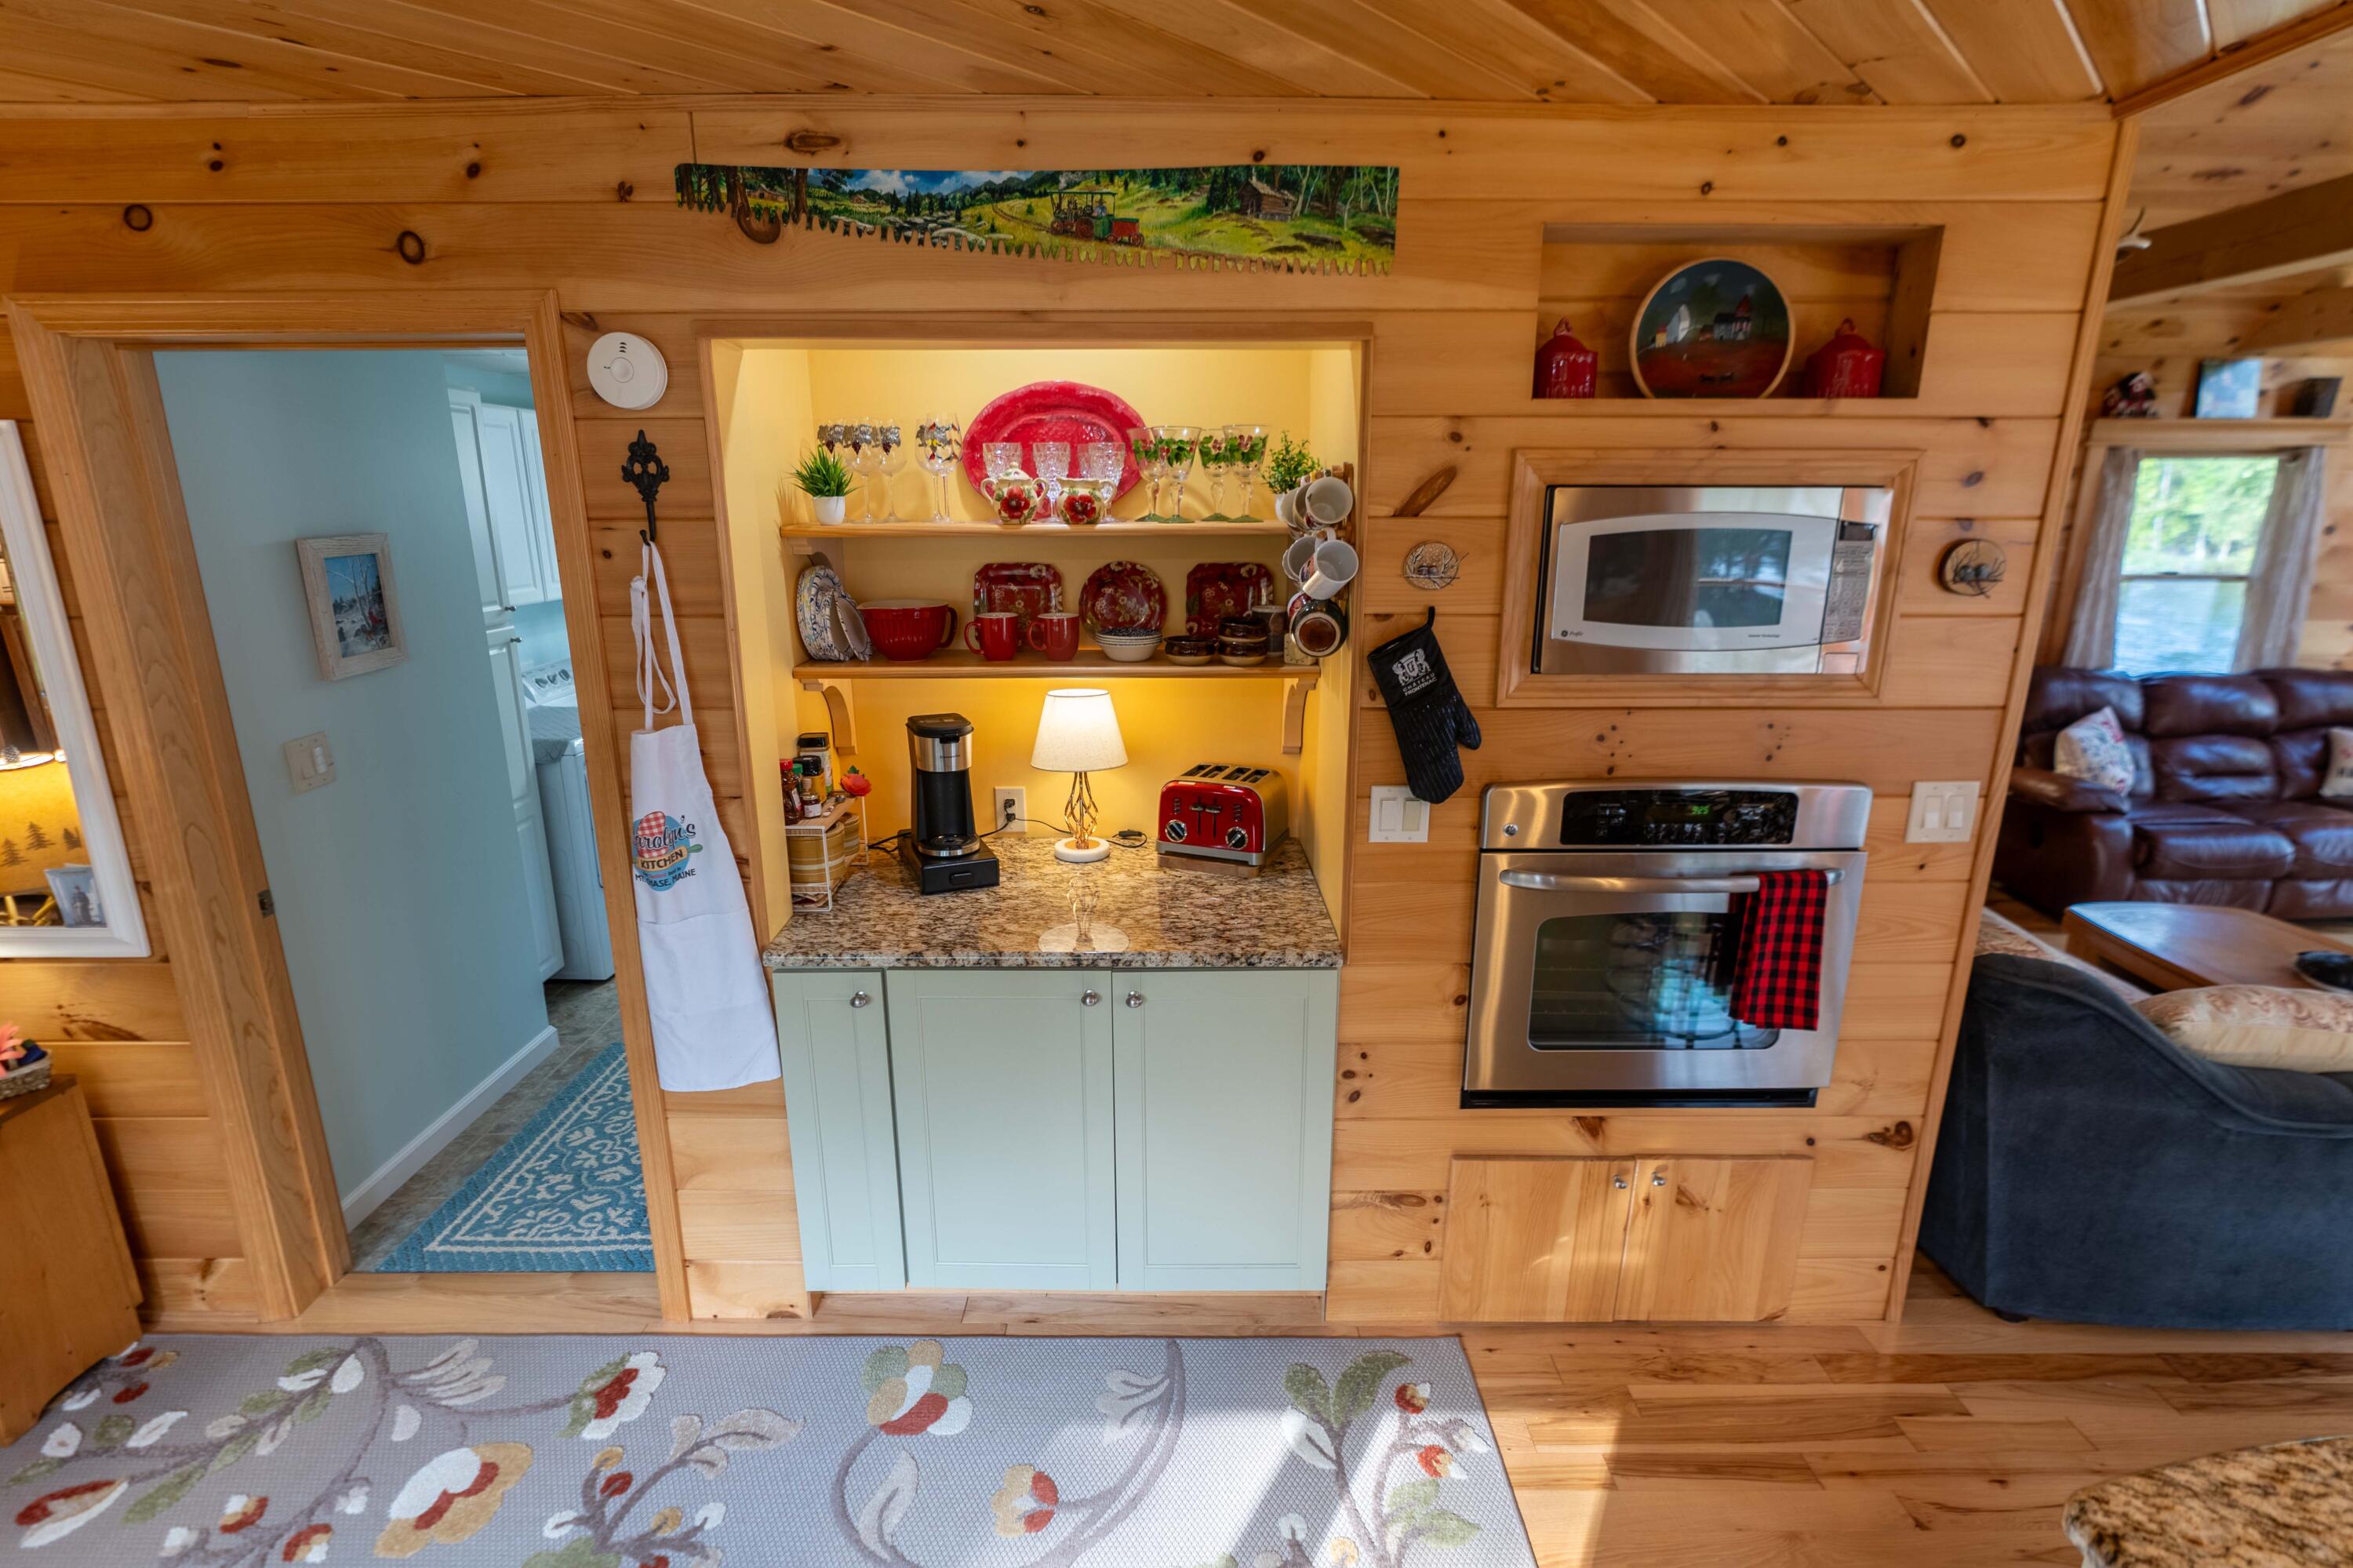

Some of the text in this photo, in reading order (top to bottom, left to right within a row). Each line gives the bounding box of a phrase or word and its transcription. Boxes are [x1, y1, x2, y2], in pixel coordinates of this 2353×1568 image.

[635, 815, 696, 850] arolyn's
[640, 849, 684, 869] KITCHEN
[672, 868, 696, 882] MAINE
